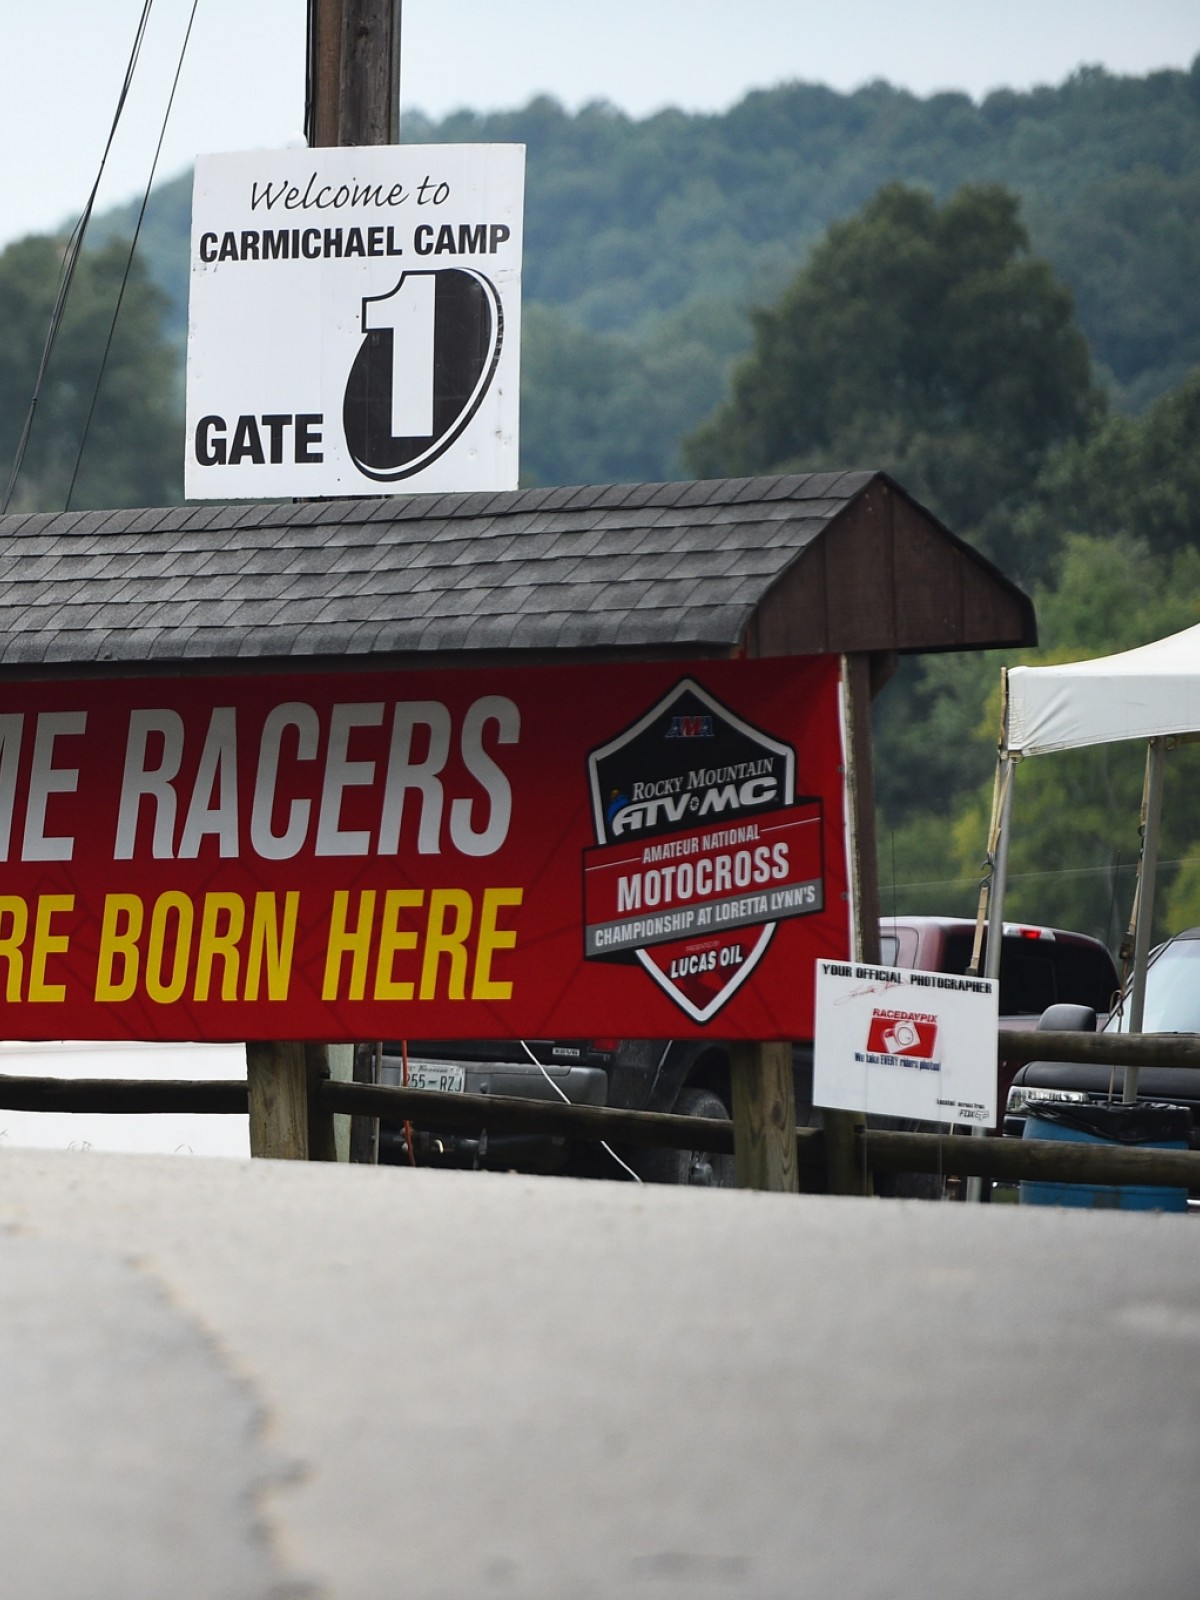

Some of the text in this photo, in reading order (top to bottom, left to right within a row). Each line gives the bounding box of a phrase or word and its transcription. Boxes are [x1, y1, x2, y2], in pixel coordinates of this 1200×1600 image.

[251, 172, 450, 211] Welcome to
[200, 224, 510, 263] CARMICHAEL CAMP
[195, 270, 436, 466] GATE 1
[113, 695, 521, 860] RACERS
[632, 757, 774, 801] ROCKY MOUNTAIN
[642, 824, 760, 864] AMATEUR NATIONAL
[617, 842, 789, 912] MOTOCROSS
[595, 885, 815, 947] CHAMPIONSHIP AT LORETTA LYNN'S
[94, 890, 300, 1004] BORN
[321, 887, 524, 1000] HERE
[671, 945, 743, 978] LUCAS OIL
[822, 964, 852, 977] YOUR
[856, 967, 902, 983] OFFICIAL
[910, 974, 992, 993] PHOTOGRAPHER
[872, 1008, 938, 1022] RACEDAYPIX
[880, 1055, 898, 1066] EVERY
